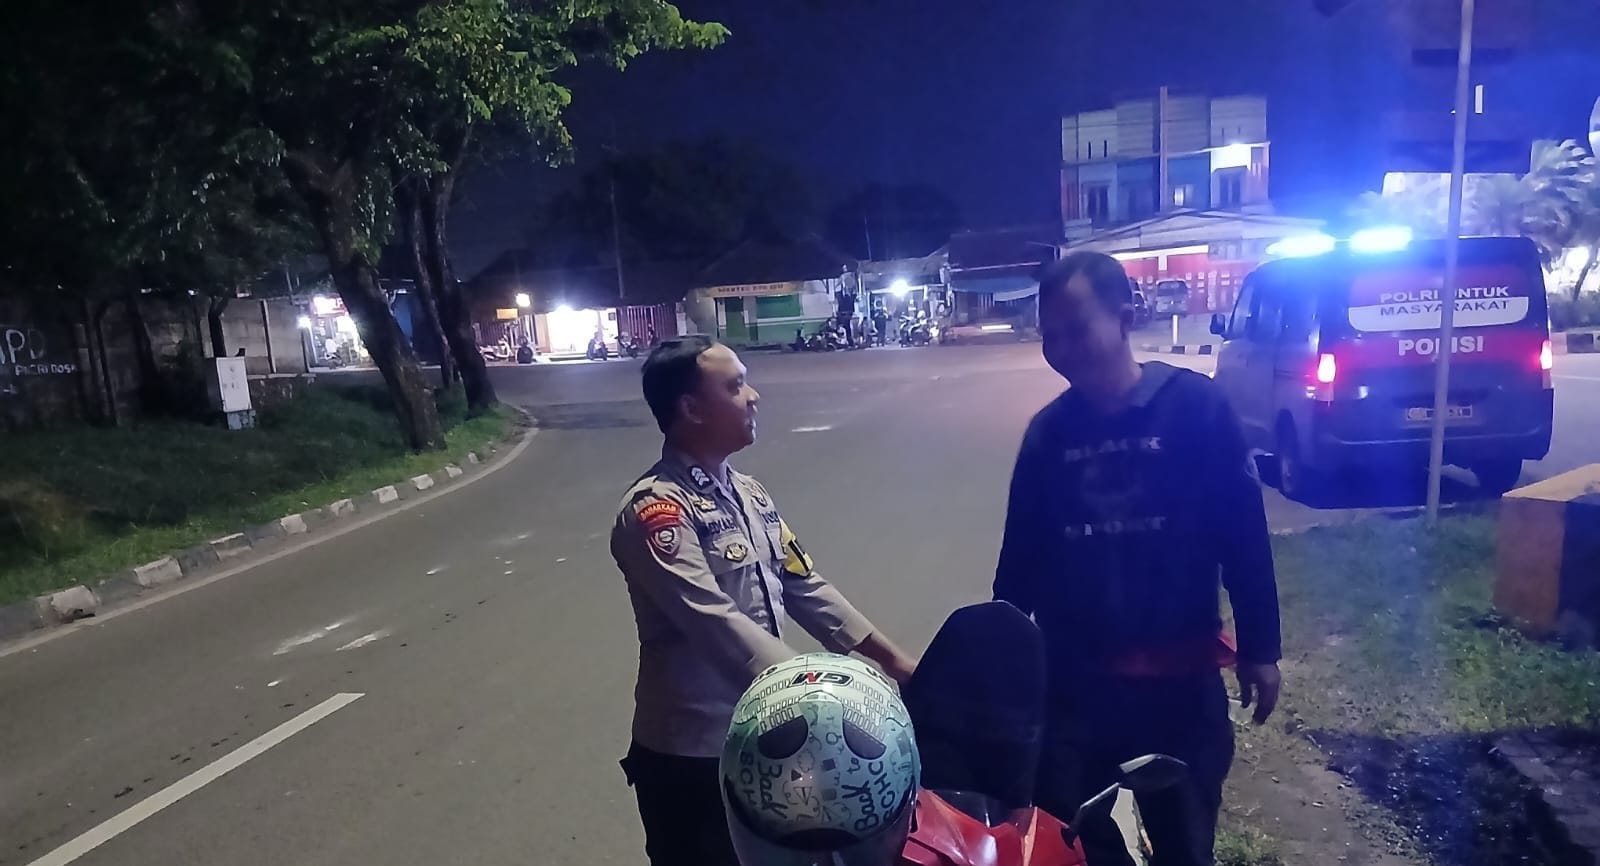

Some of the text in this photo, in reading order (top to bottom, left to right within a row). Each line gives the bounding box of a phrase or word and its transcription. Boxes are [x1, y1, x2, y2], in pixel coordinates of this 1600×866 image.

[1380, 286, 1510, 303] POLRI NTUK
[792, 672, 851, 685] GM
[842, 780, 879, 832] Back
